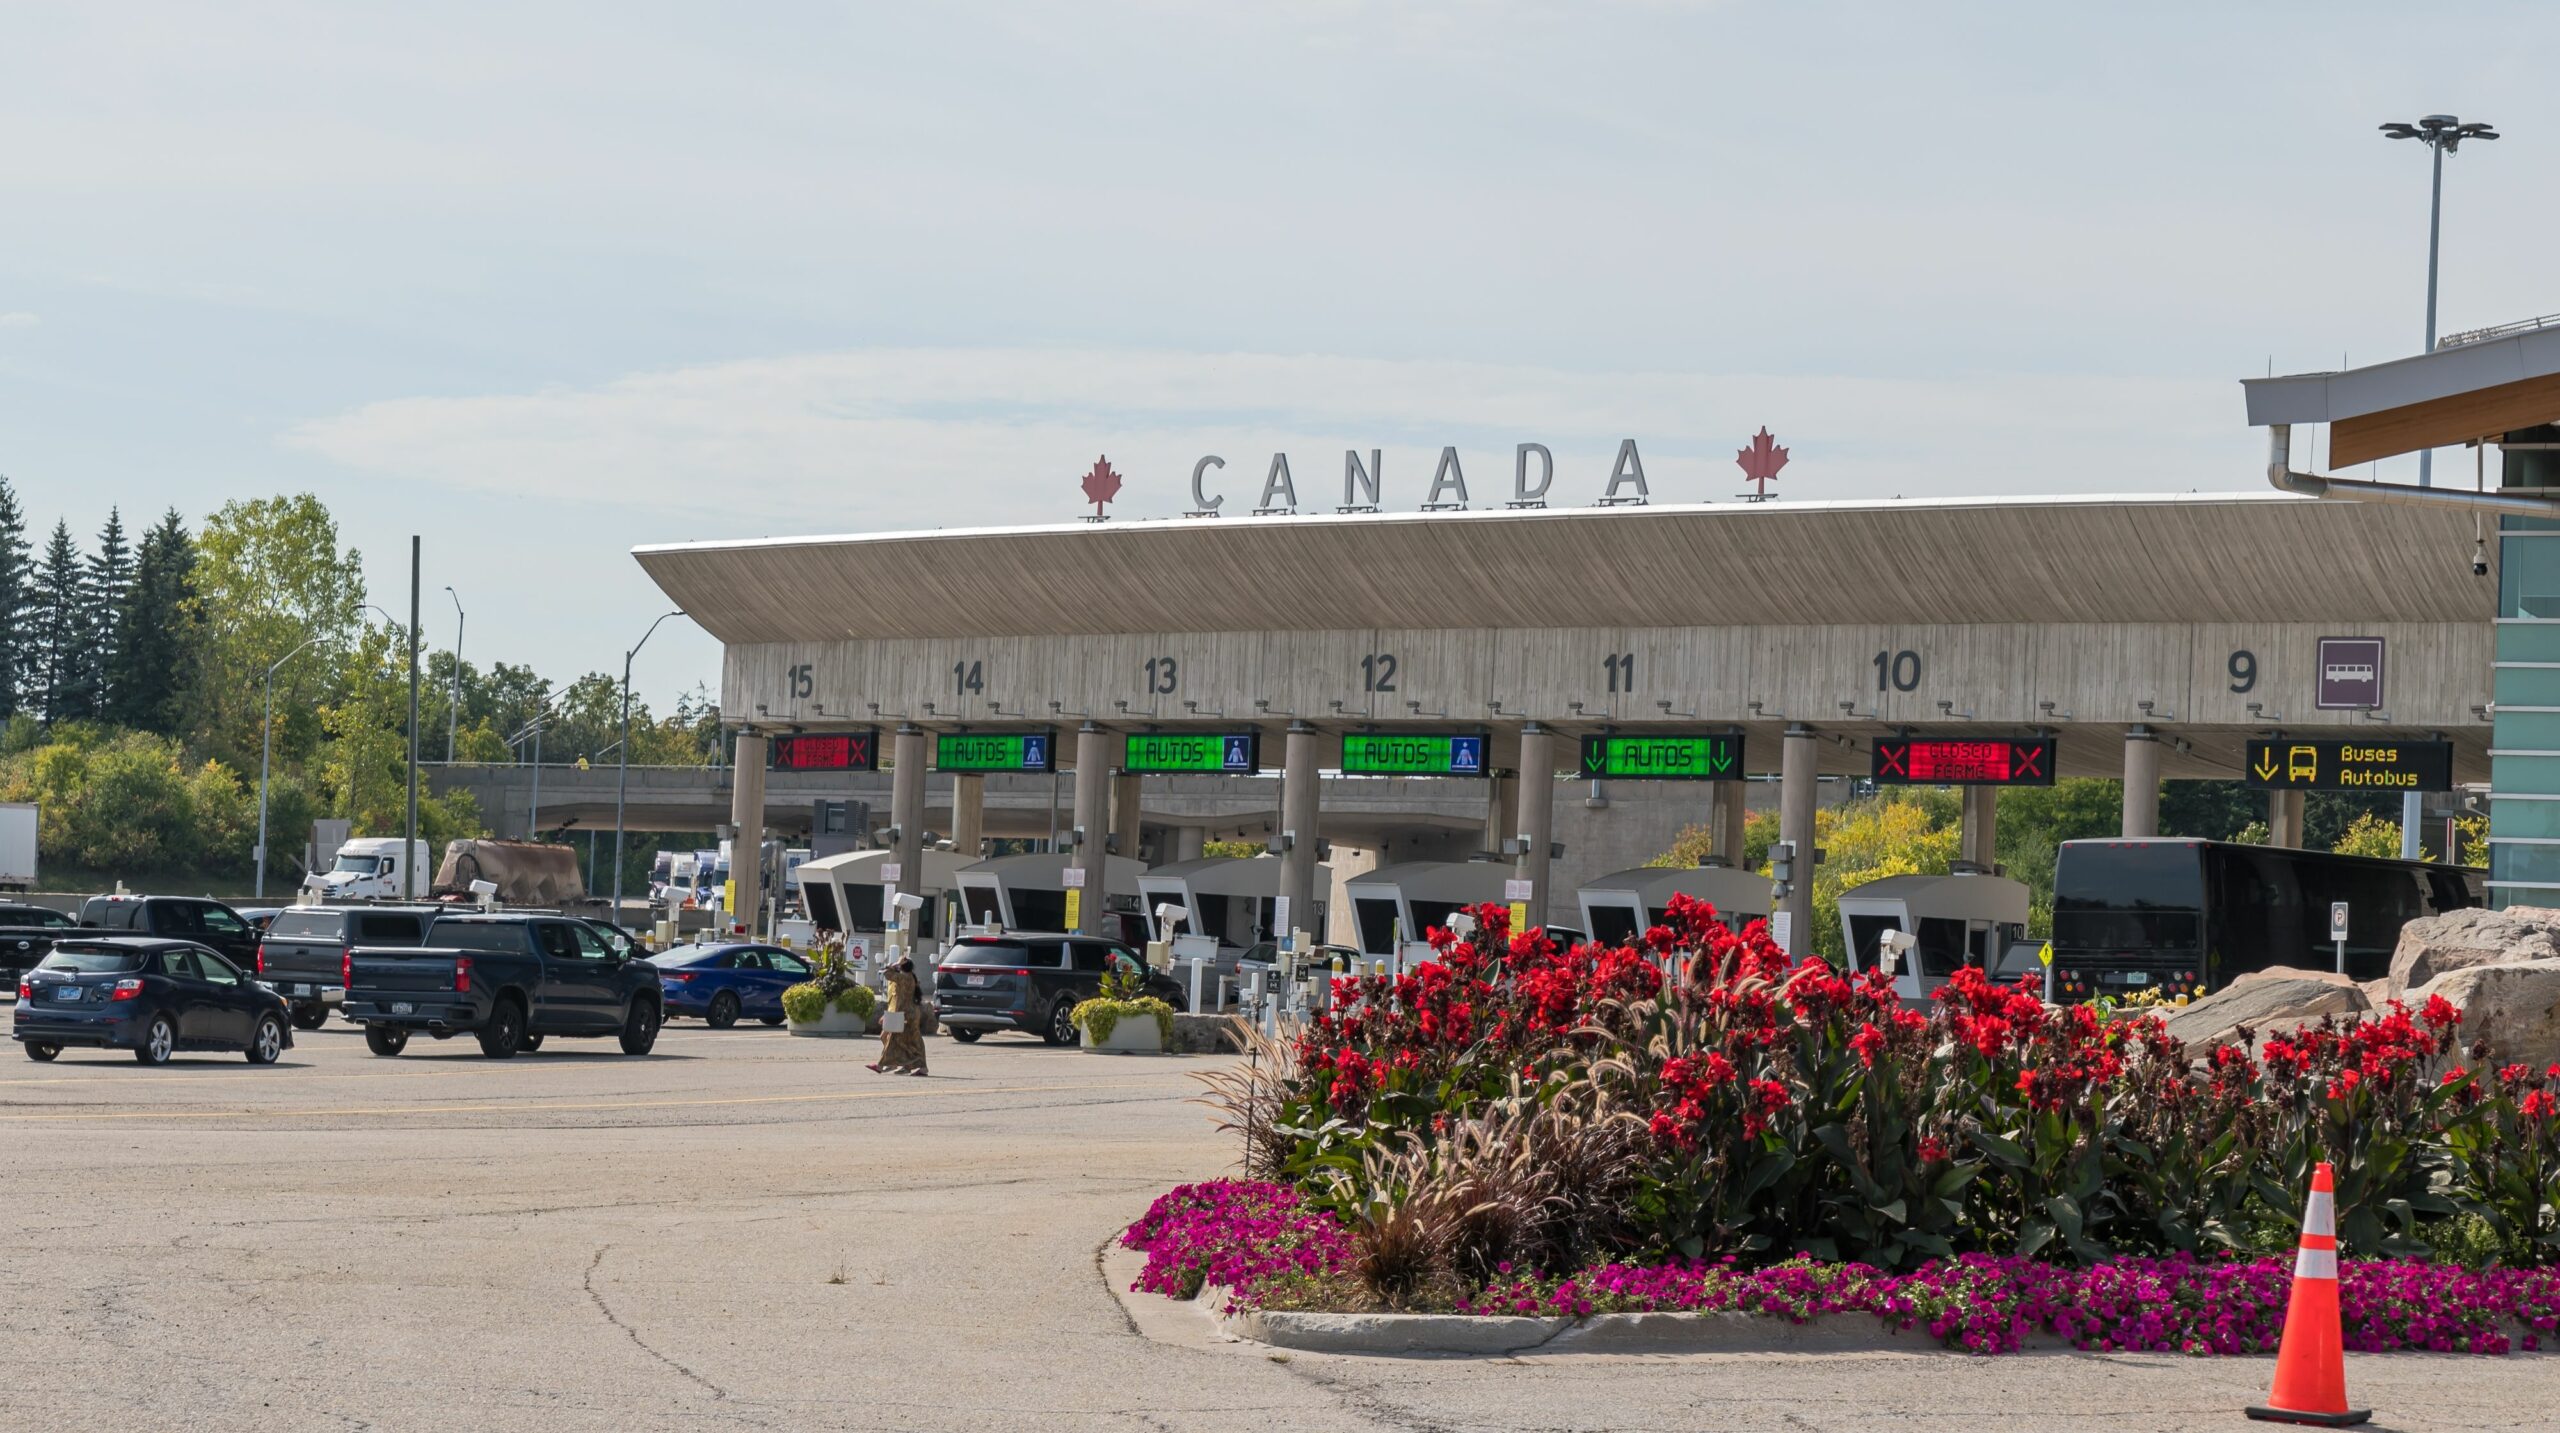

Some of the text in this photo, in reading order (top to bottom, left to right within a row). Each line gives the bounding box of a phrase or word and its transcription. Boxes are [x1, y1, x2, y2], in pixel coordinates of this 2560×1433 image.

[1192, 439, 1649, 509] CANADA
[788, 664, 813, 698] 15
[954, 661, 984, 695] 14
[1145, 657, 1177, 694] 13
[1361, 654, 1397, 692] 12
[1603, 653, 1634, 692] 11
[1874, 650, 1921, 692] 10
[2228, 650, 2257, 694] 9
[955, 742, 1006, 762] AUTOS
[1146, 742, 1204, 763] AUTOS
[1364, 743, 1429, 764] AUTOS
[1625, 744, 1692, 768] AUTOS
[1929, 743, 1992, 759] CLOSED
[2341, 746, 2398, 762] Buses
[2341, 769, 2418, 786] Autobus
[1127, 896, 1139, 911] 14
[2013, 925, 2023, 940] 10
